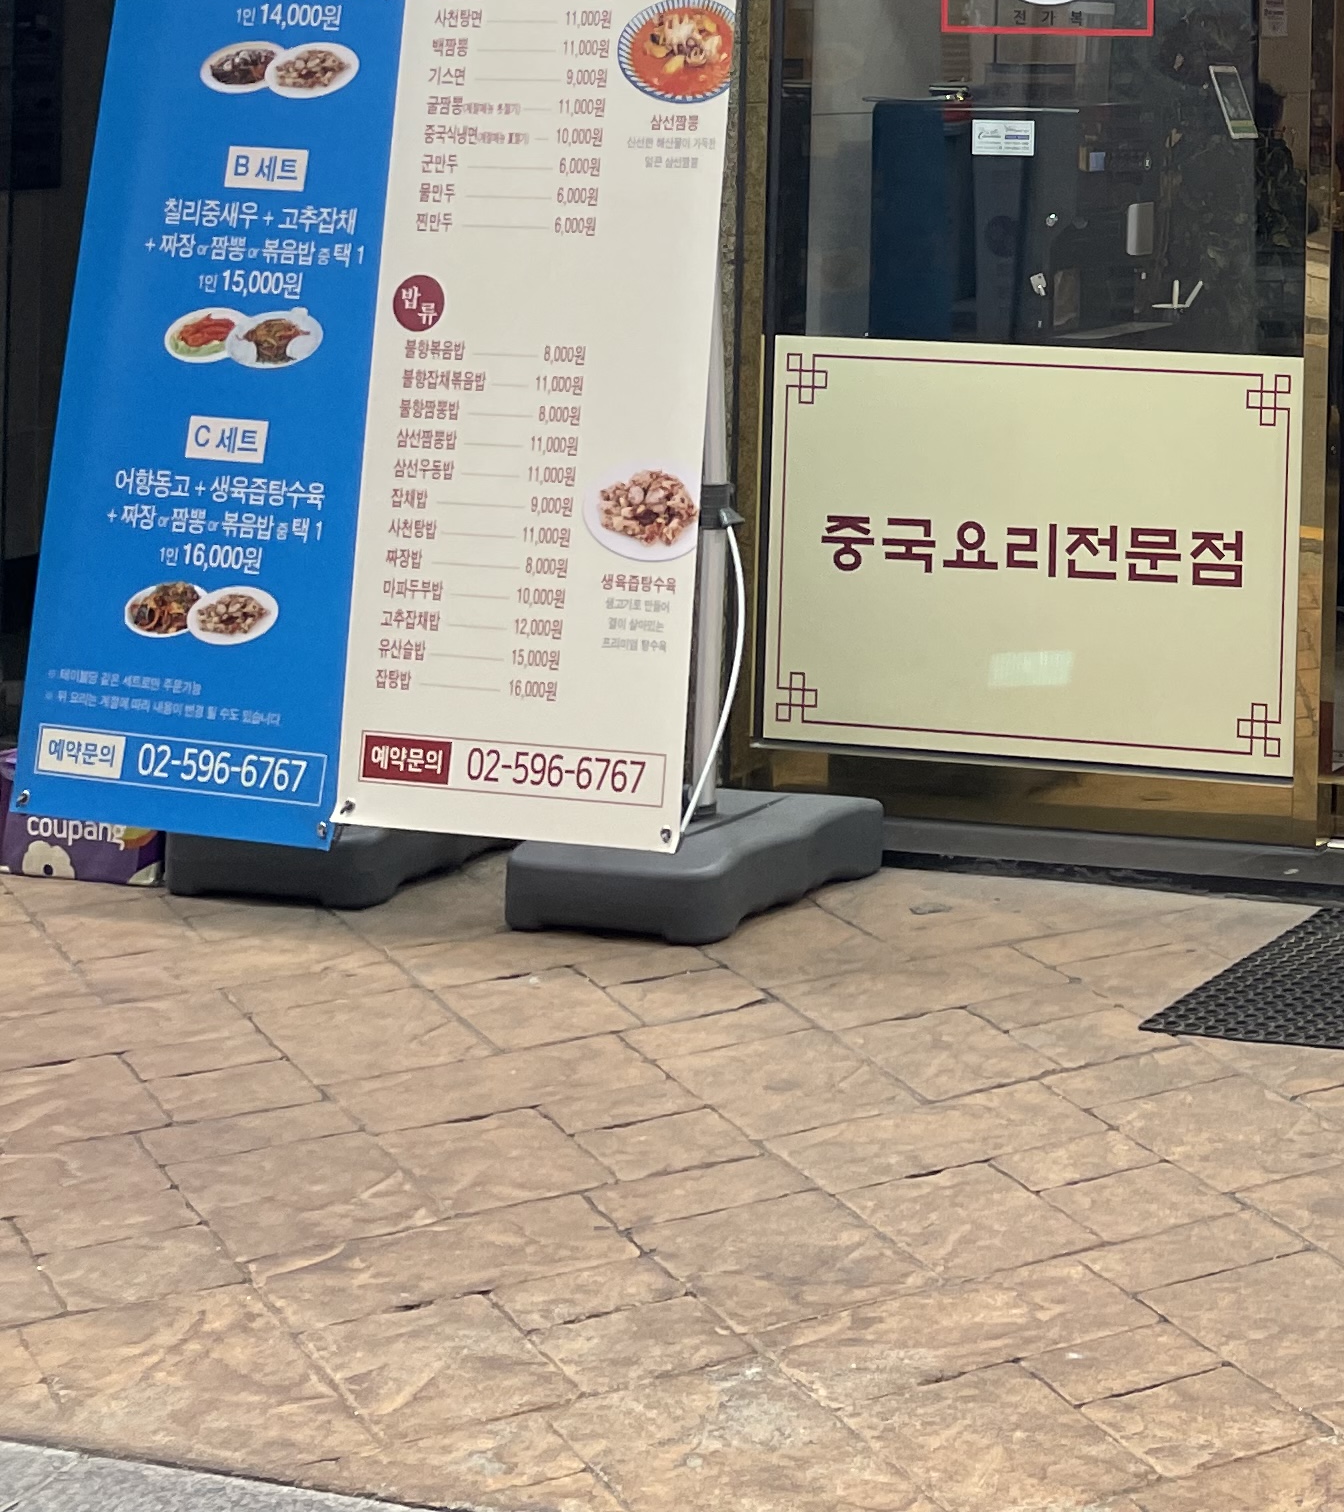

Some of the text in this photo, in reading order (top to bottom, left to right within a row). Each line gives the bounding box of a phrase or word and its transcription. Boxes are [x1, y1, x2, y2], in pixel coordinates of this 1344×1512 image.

[260, 3, 342, 31] 14,000원
[434, 9, 612, 29] 사천탕면 11,000원
[563, 38, 610, 58] 11,000원
[428, 67, 608, 88] 기스면 9,000원
[558, 98, 606, 118] 11,000원
[556, 127, 603, 148] 10,000원
[650, 114, 699, 132] 삼선짬뽕
[234, 155, 298, 182] B 세트
[421, 154, 601, 177] 군만두 6,000원
[419, 183, 599, 207] 물만두 6,000원
[164, 197, 357, 235] 칠리중새우 고추잡채
[415, 212, 597, 237] 찐만두 6,000원
[159, 233, 316, 266] 짜장 짬뽕 볶음밥
[222, 269, 303, 300] 15,000원
[543, 345, 587, 366] 8,000원
[535, 375, 584, 396] 11,000원
[538, 406, 581, 426] 8,000원
[194, 425, 259, 454] C 세트
[530, 436, 579, 456] 11,000원
[115, 468, 326, 510] 어향동고 생육즙탕수육
[527, 466, 576, 487] 11,000원
[390, 488, 574, 517] 잡채밥 9,000원
[121, 504, 275, 541] 짜장 짬뽕 볶음밥
[388, 518, 571, 548] 사천탕밥 11,000원
[183, 544, 263, 575] 16,000원
[386, 549, 569, 579] 짜장밥 8,000원
[821, 515, 1244, 588] 중국요리전문점
[383, 579, 566, 610] 마파두부밥 10,000원
[380, 610, 563, 640] 고추잡채밥 12,000원
[378, 639, 560, 671] 유산슬밥 15,000원
[375, 669, 558, 702] 잡탕밥 16,000원
[48, 738, 307, 793] 예약문의 02-596-6767
[370, 745, 647, 794] 예약문의 02-596-6767
[27, 816, 127, 851] coupang
